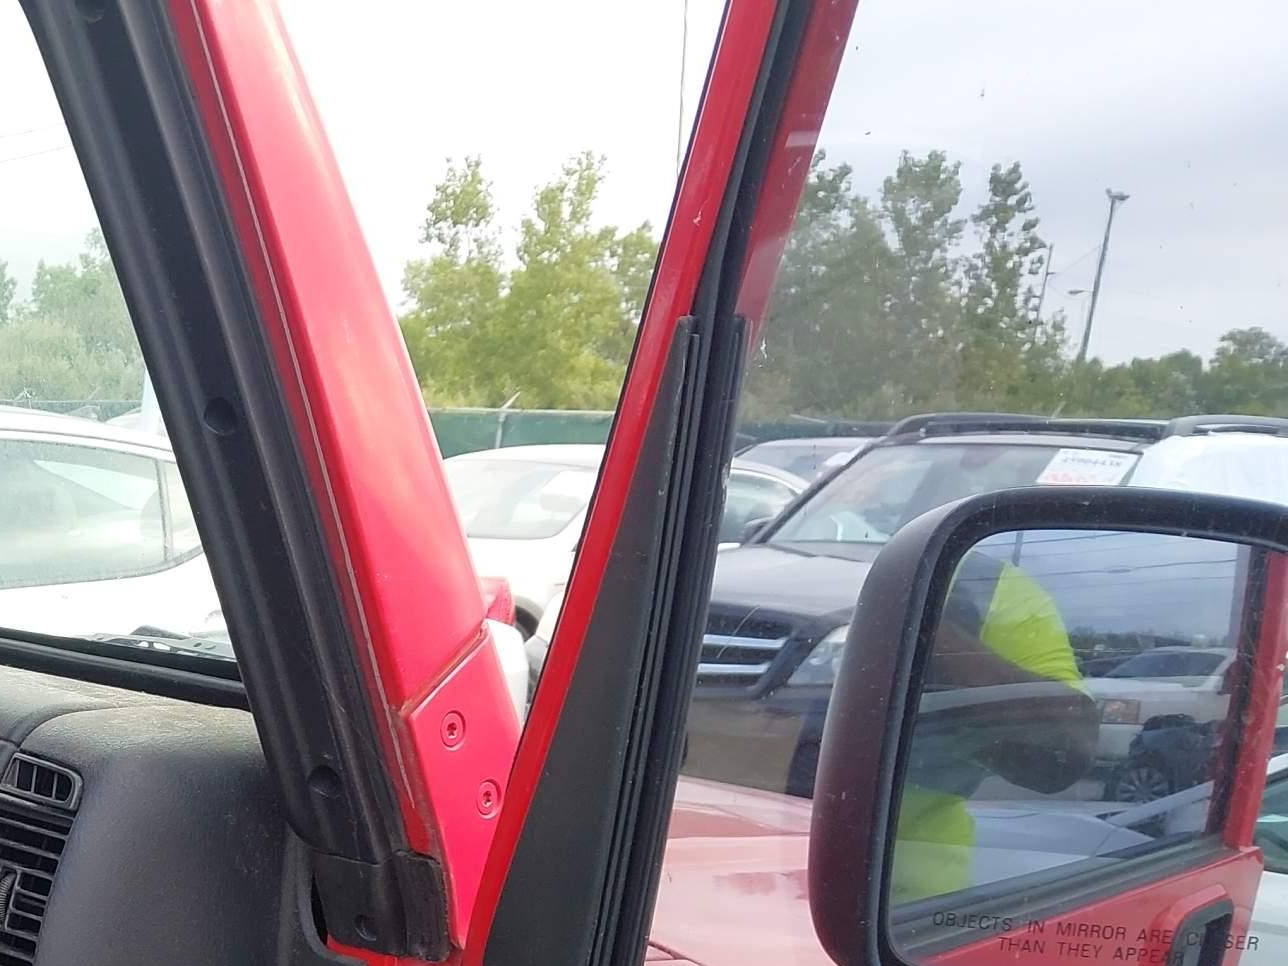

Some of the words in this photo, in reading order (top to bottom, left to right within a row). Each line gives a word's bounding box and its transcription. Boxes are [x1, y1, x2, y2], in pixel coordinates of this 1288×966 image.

[932, 911, 1012, 931] OBJECTS
[1027, 920, 1046, 934] IN
[1056, 922, 1127, 941] MIRROR
[1136, 928, 1173, 945] ARE
[997, 936, 1047, 954] THAN
[1056, 941, 1104, 959] THEY
[1113, 947, 1185, 966] APPEAR
